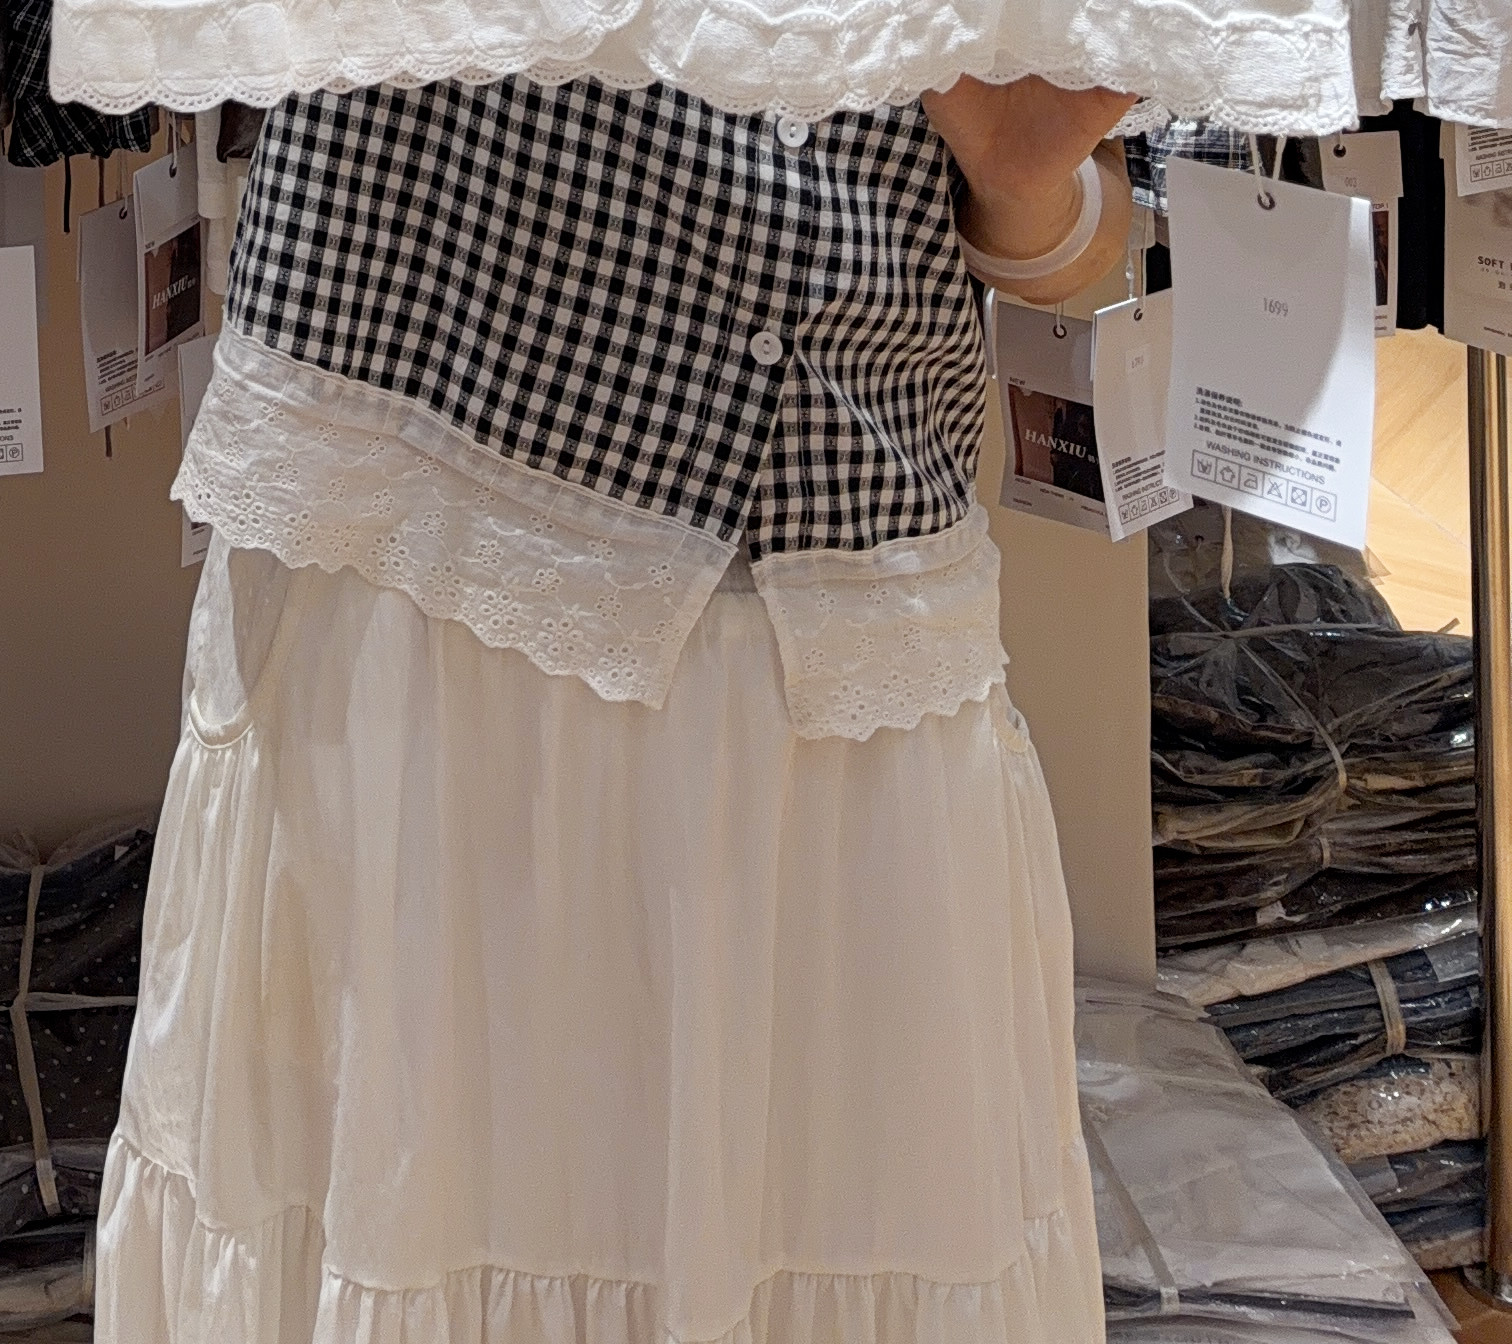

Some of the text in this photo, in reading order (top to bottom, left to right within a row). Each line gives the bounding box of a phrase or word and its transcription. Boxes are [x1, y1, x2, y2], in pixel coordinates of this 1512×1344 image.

[1477, 255, 1505, 269] SOFT
[152, 275, 189, 310] HANXIU
[1009, 376, 1026, 386] NEW
[1024, 428, 1087, 459] HANXIU
[1206, 440, 1326, 485] WASHING INSTRUCTIONS
